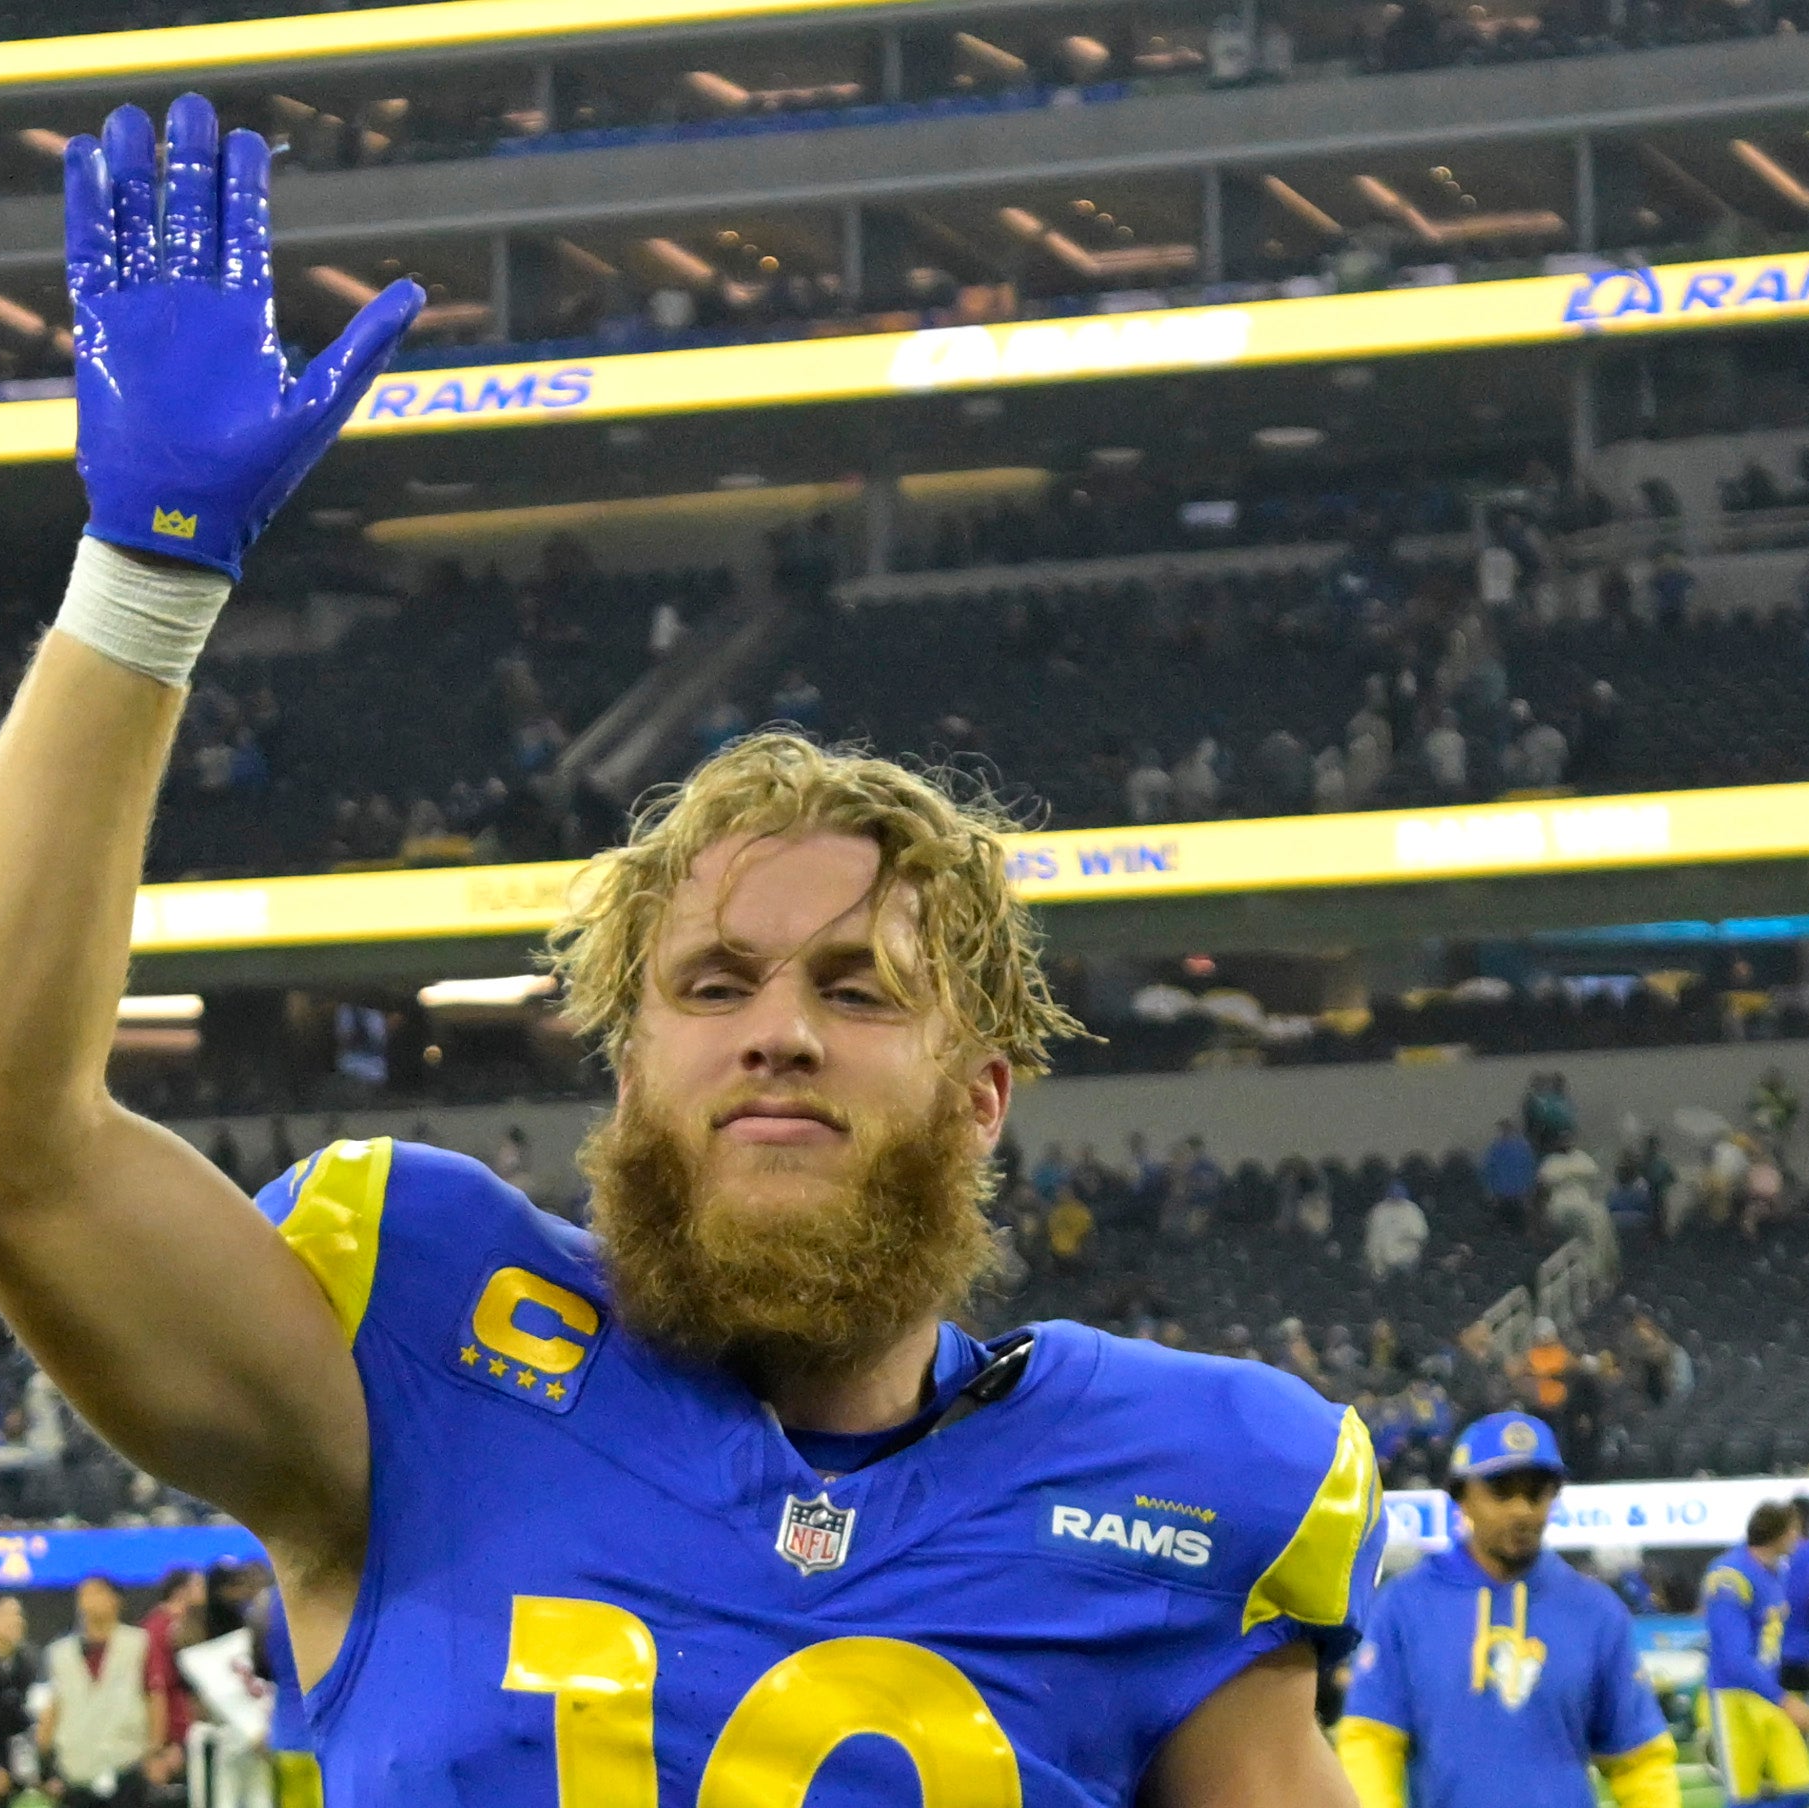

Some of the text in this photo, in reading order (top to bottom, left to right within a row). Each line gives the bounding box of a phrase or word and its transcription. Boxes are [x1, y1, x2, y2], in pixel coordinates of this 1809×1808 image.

[368, 367, 595, 420] RAMS
[473, 1266, 600, 1374] C
[789, 1525, 835, 1560] NFL
[1052, 1504, 1213, 1566] RAMS
